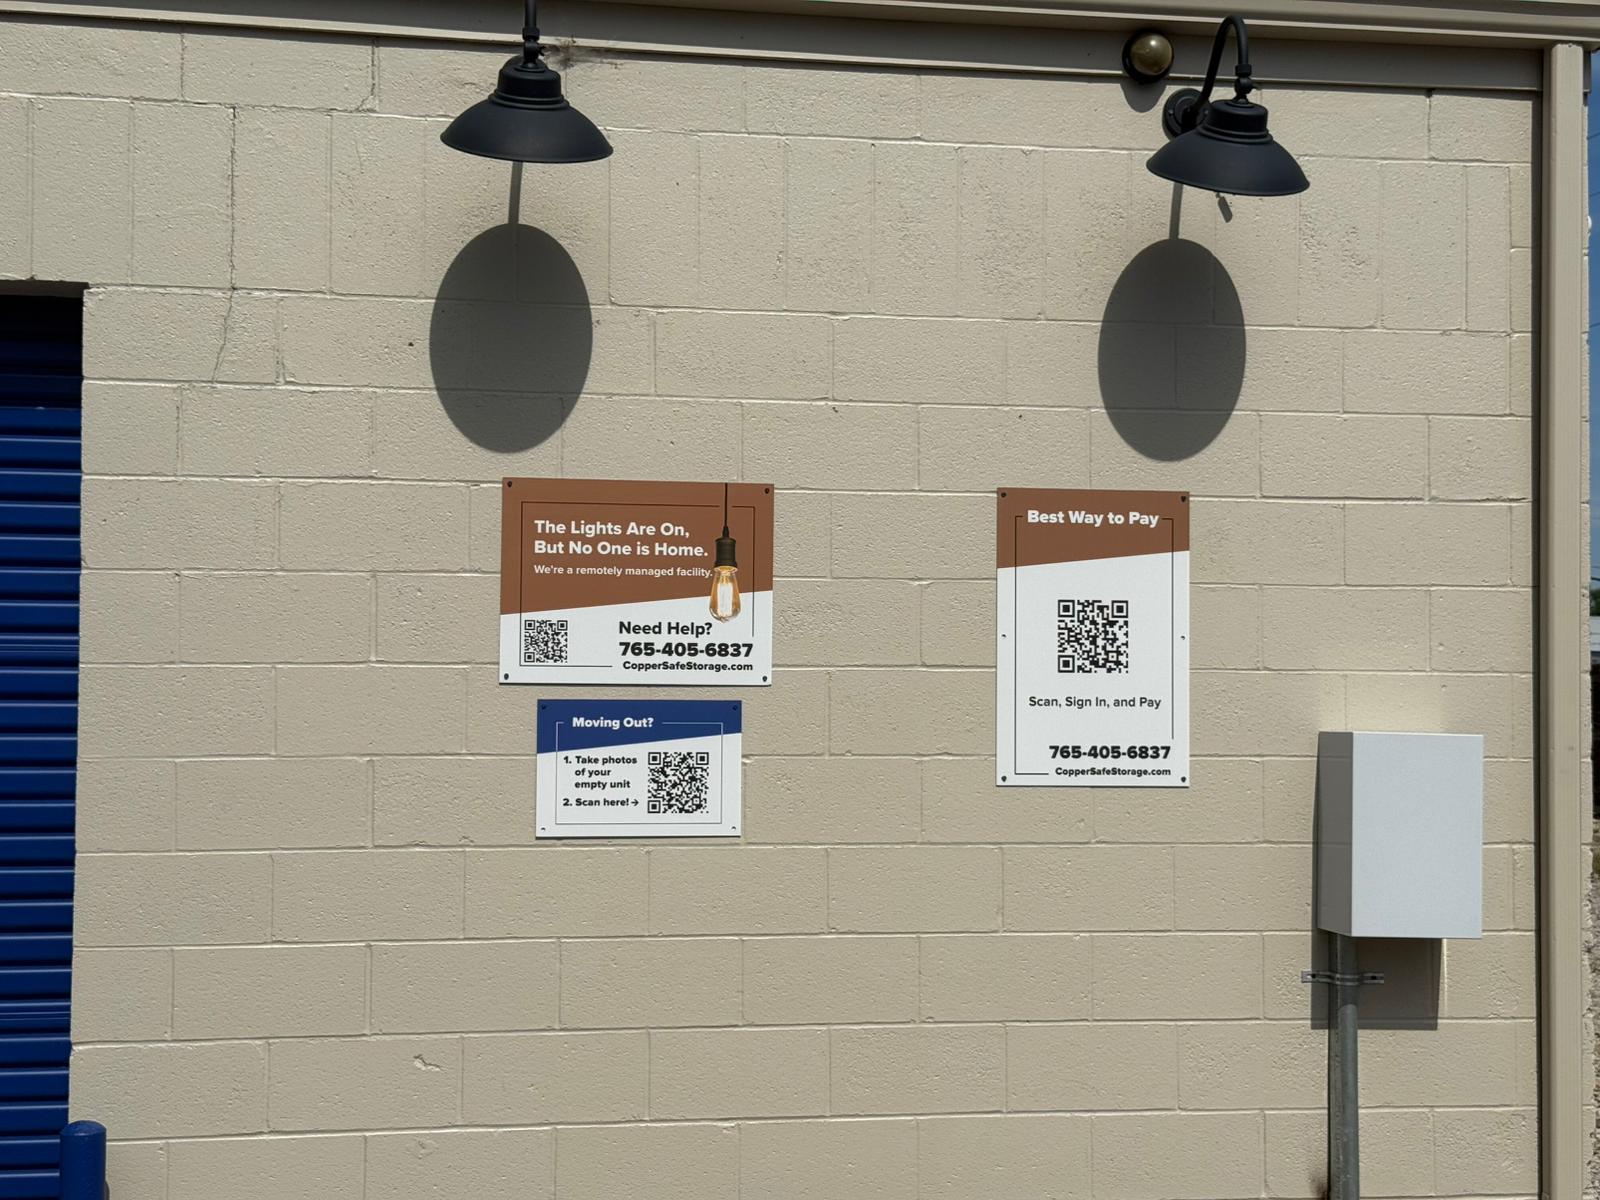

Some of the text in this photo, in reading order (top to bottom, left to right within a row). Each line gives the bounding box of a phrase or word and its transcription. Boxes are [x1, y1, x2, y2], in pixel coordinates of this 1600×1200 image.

[1027, 509, 1159, 528] Best Way to Pay
[534, 519, 690, 539] The Lights Are On,
[534, 540, 708, 557] But No One is Home.
[534, 564, 713, 579] We're a remotely managed facility.
[618, 621, 713, 639] Need Help?
[618, 642, 754, 658] 765-405-6837
[622, 661, 754, 673] CopperSafeStorage.com
[1028, 696, 1162, 711] Scan, Sign In, and Pay
[572, 717, 654, 730] Moving Out?
[1048, 745, 1171, 760] 765-405-6837
[563, 755, 638, 766] 1. Take photos
[574, 767, 611, 778] of your
[1054, 766, 1172, 777] CopperSafeStorage.com
[574, 779, 631, 790] empty unit
[562, 797, 630, 807] 2. Scan here!
